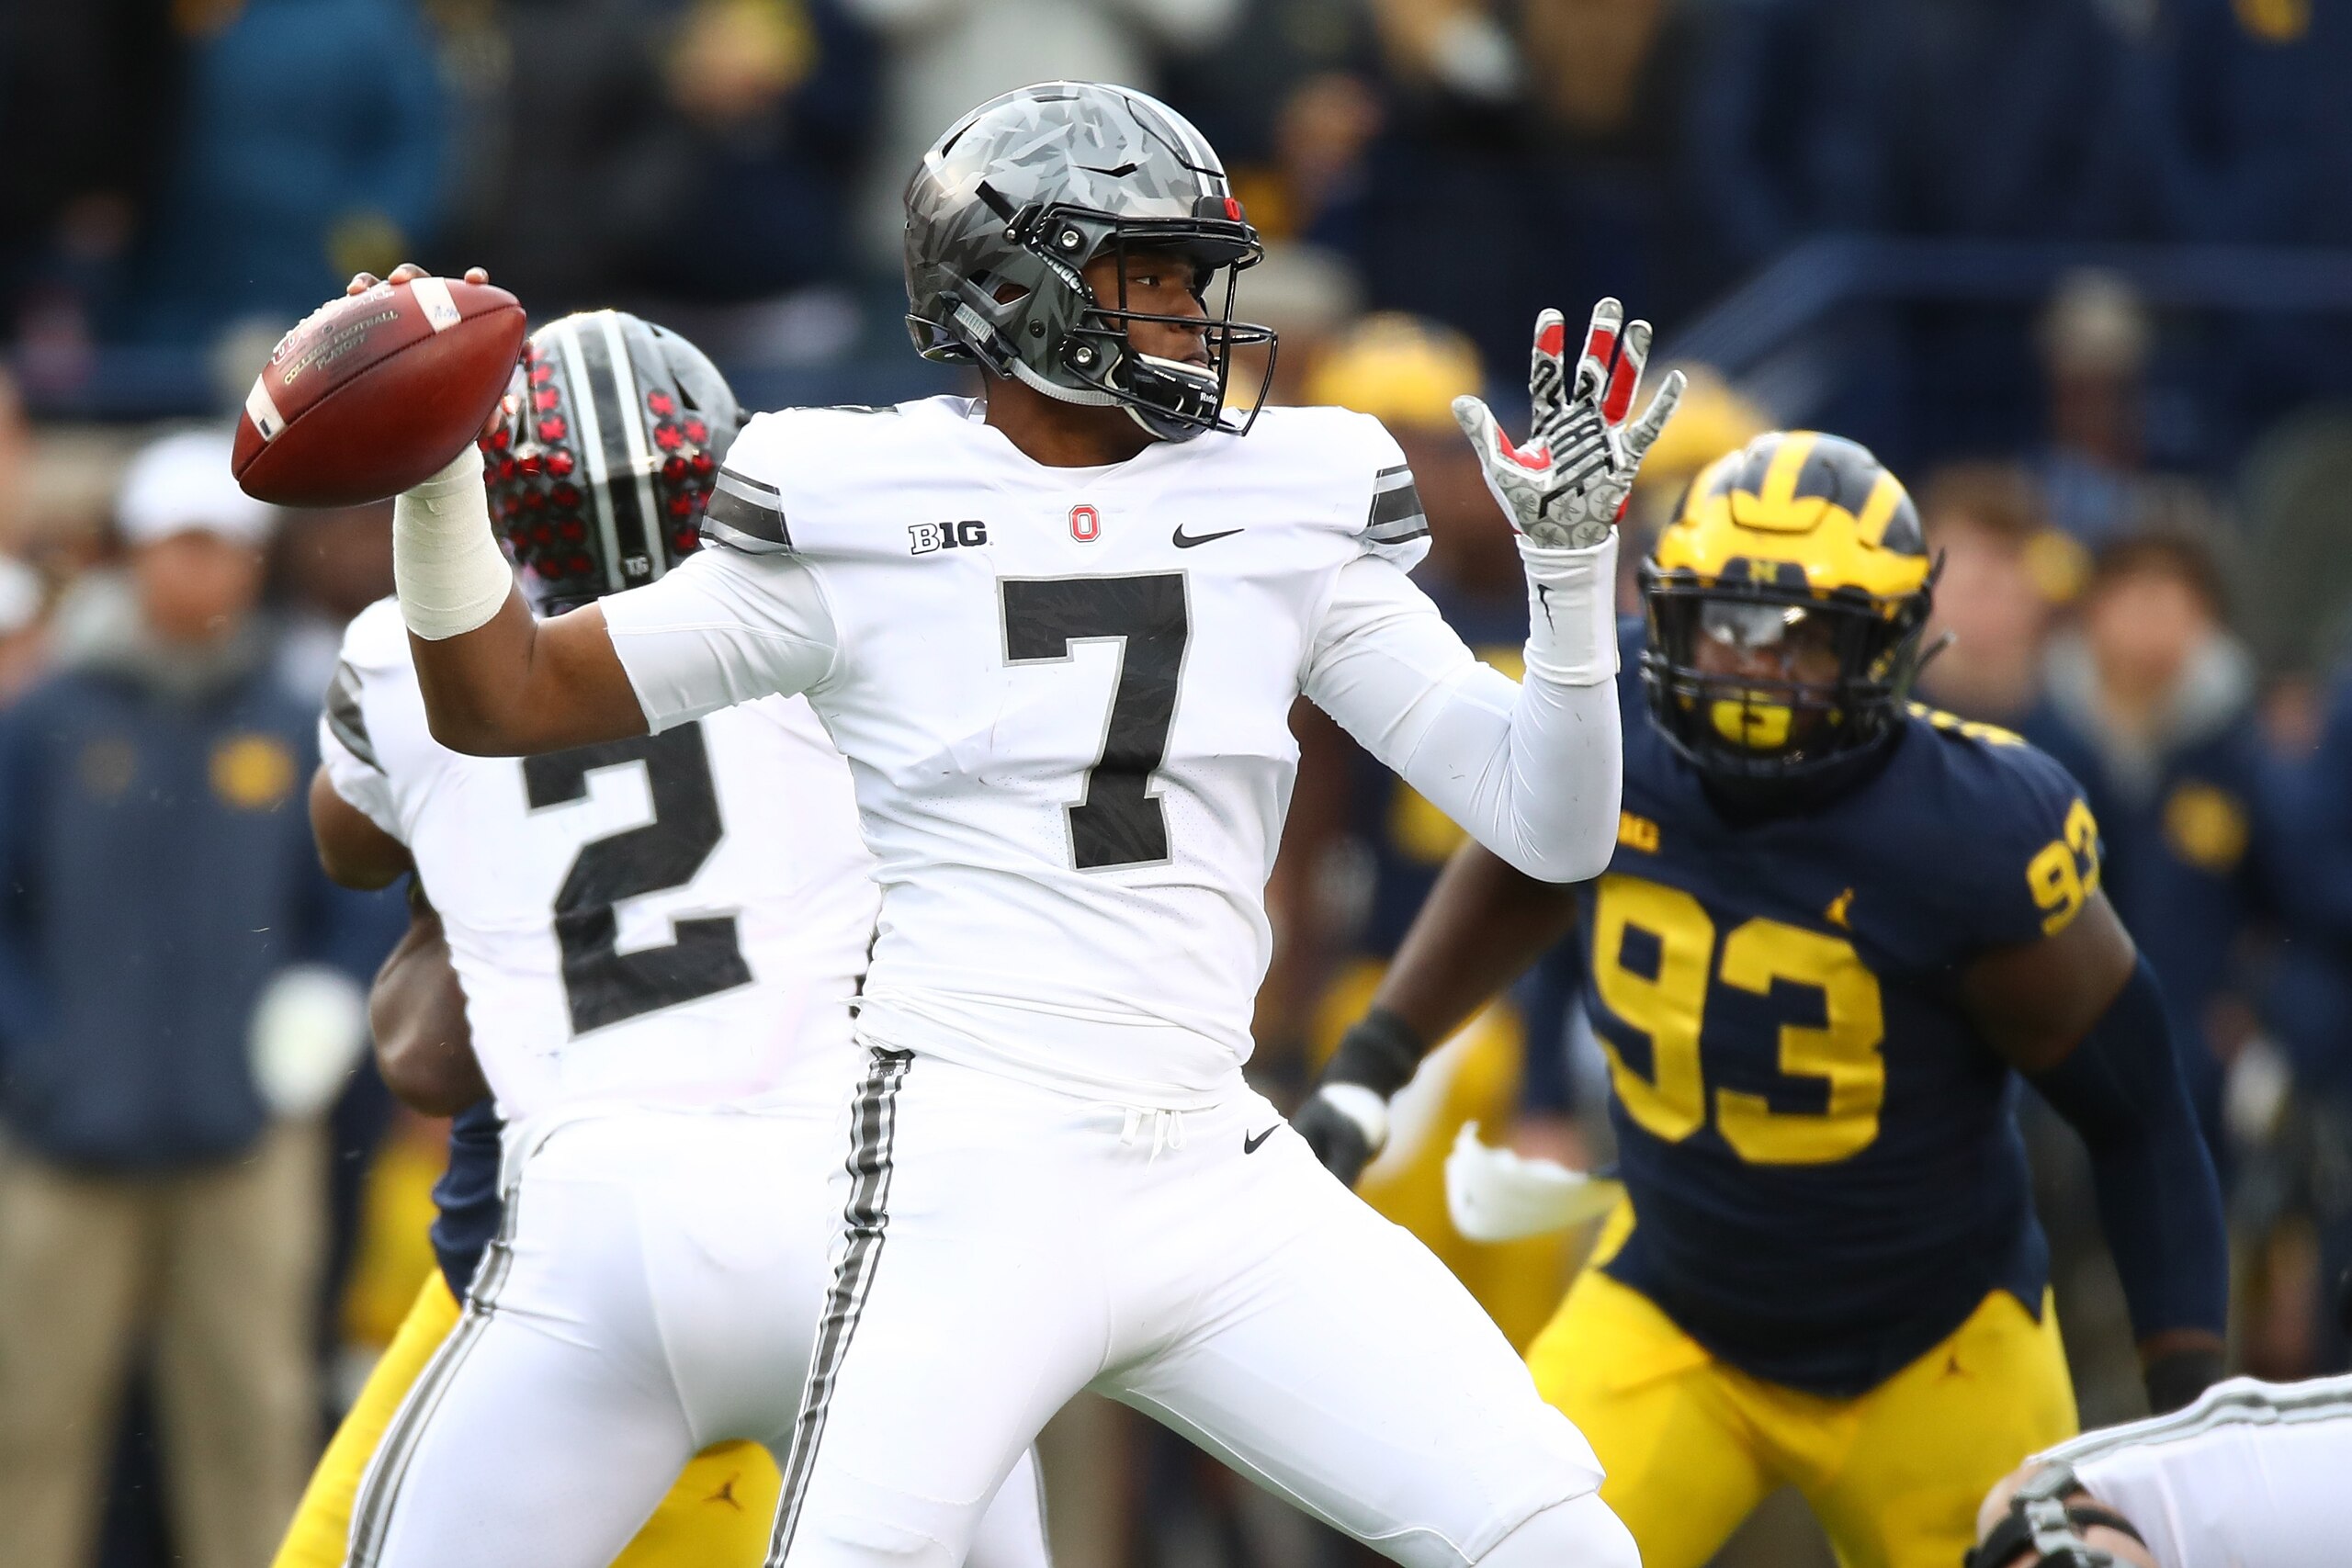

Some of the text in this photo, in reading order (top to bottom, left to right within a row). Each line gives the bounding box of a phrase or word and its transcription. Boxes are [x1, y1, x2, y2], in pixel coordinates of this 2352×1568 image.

[283, 342, 331, 385] COLLEGE
[334, 310, 399, 344] FOOTBALL
[314, 333, 368, 372] PLAYOFF
[1069, 503, 1102, 543] O
[995, 568, 1194, 873] 7
[521, 720, 756, 1041] 2
[2029, 798, 2101, 935] 93
[1594, 875, 1886, 1165] 93
